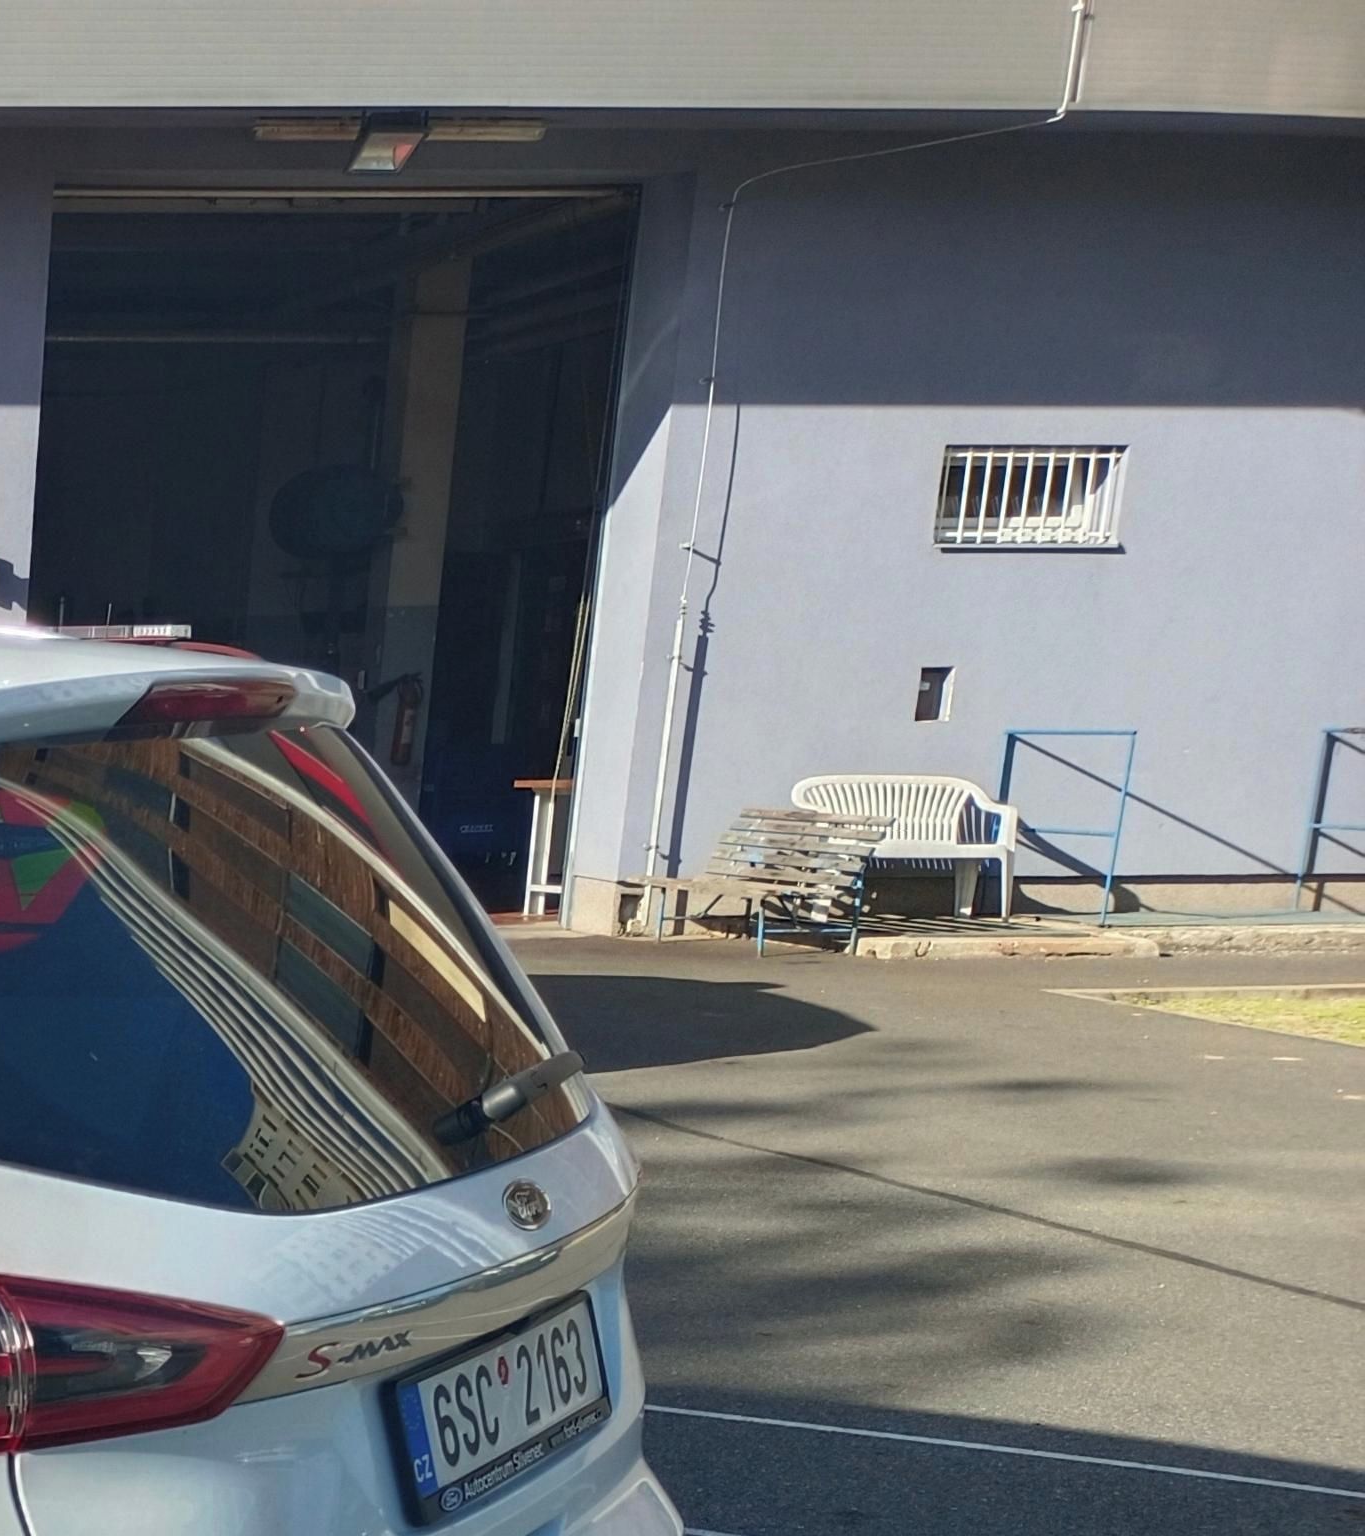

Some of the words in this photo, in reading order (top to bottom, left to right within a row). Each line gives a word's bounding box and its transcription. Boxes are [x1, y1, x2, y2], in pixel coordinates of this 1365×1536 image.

[294, 1329, 412, 1379] S-MAX
[433, 1364, 499, 1467] 6SC
[516, 1318, 587, 1426] 2163
[413, 1454, 433, 1483] CZ
[463, 1461, 515, 1500] Autocentrum
